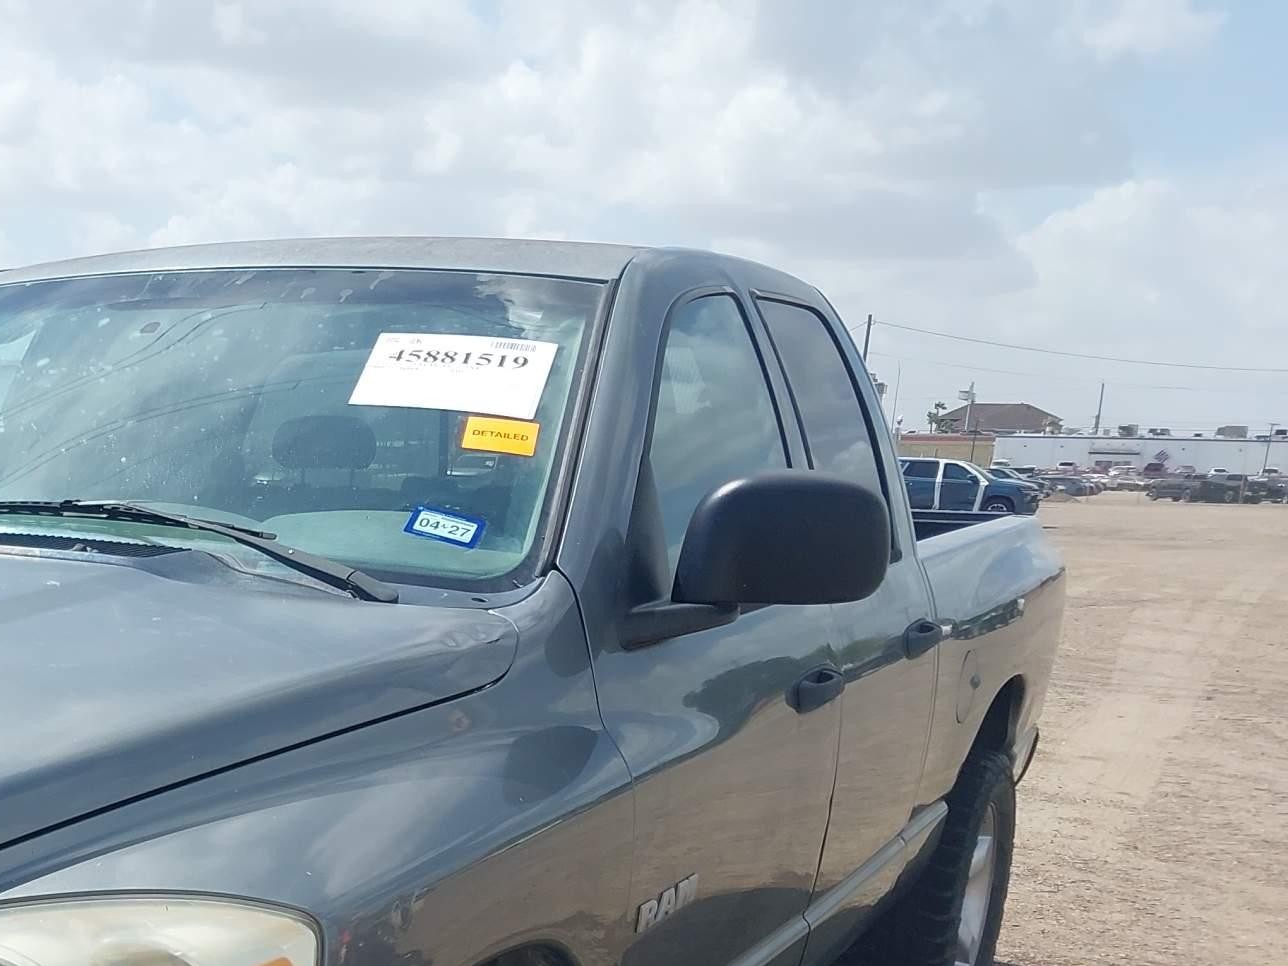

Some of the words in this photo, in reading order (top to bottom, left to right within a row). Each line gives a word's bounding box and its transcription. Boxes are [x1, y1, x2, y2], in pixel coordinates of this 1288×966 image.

[388, 349, 529, 369] 45881519
[472, 429, 529, 442] DETAILED
[634, 872, 699, 933] RAM
